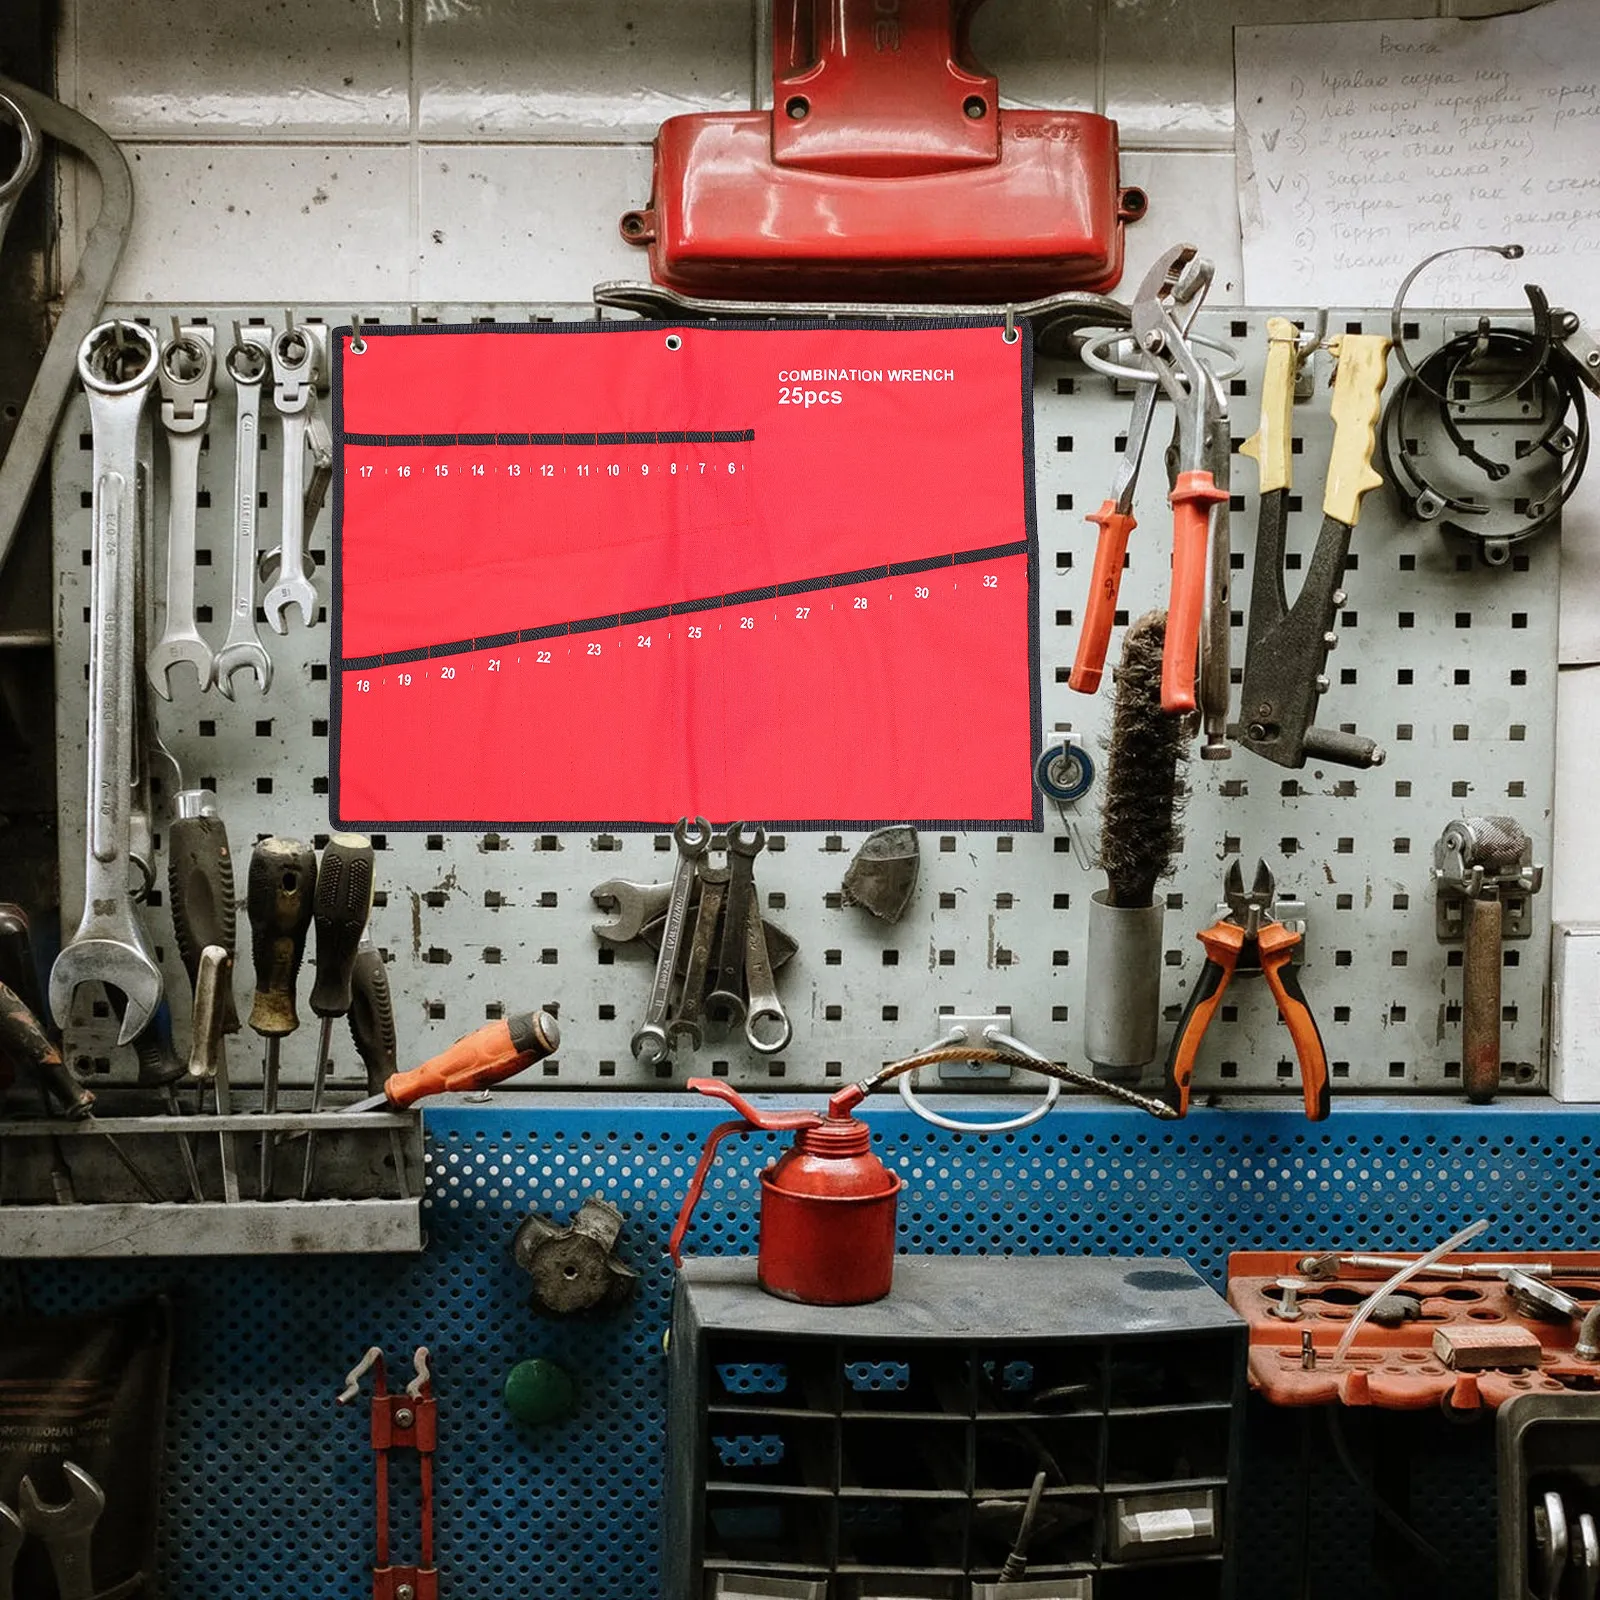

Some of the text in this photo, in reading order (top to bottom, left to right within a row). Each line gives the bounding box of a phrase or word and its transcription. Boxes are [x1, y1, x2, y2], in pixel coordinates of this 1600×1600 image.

[778, 369, 955, 383] COMBINATION WRENCH
[778, 386, 843, 409] 25pcs
[359, 462, 736, 478] 17 16 15 14 13 12 11 10 9 8 7 6
[356, 575, 998, 693] 18 19 20 21 22 23 24 25 26 27 28 30 32
